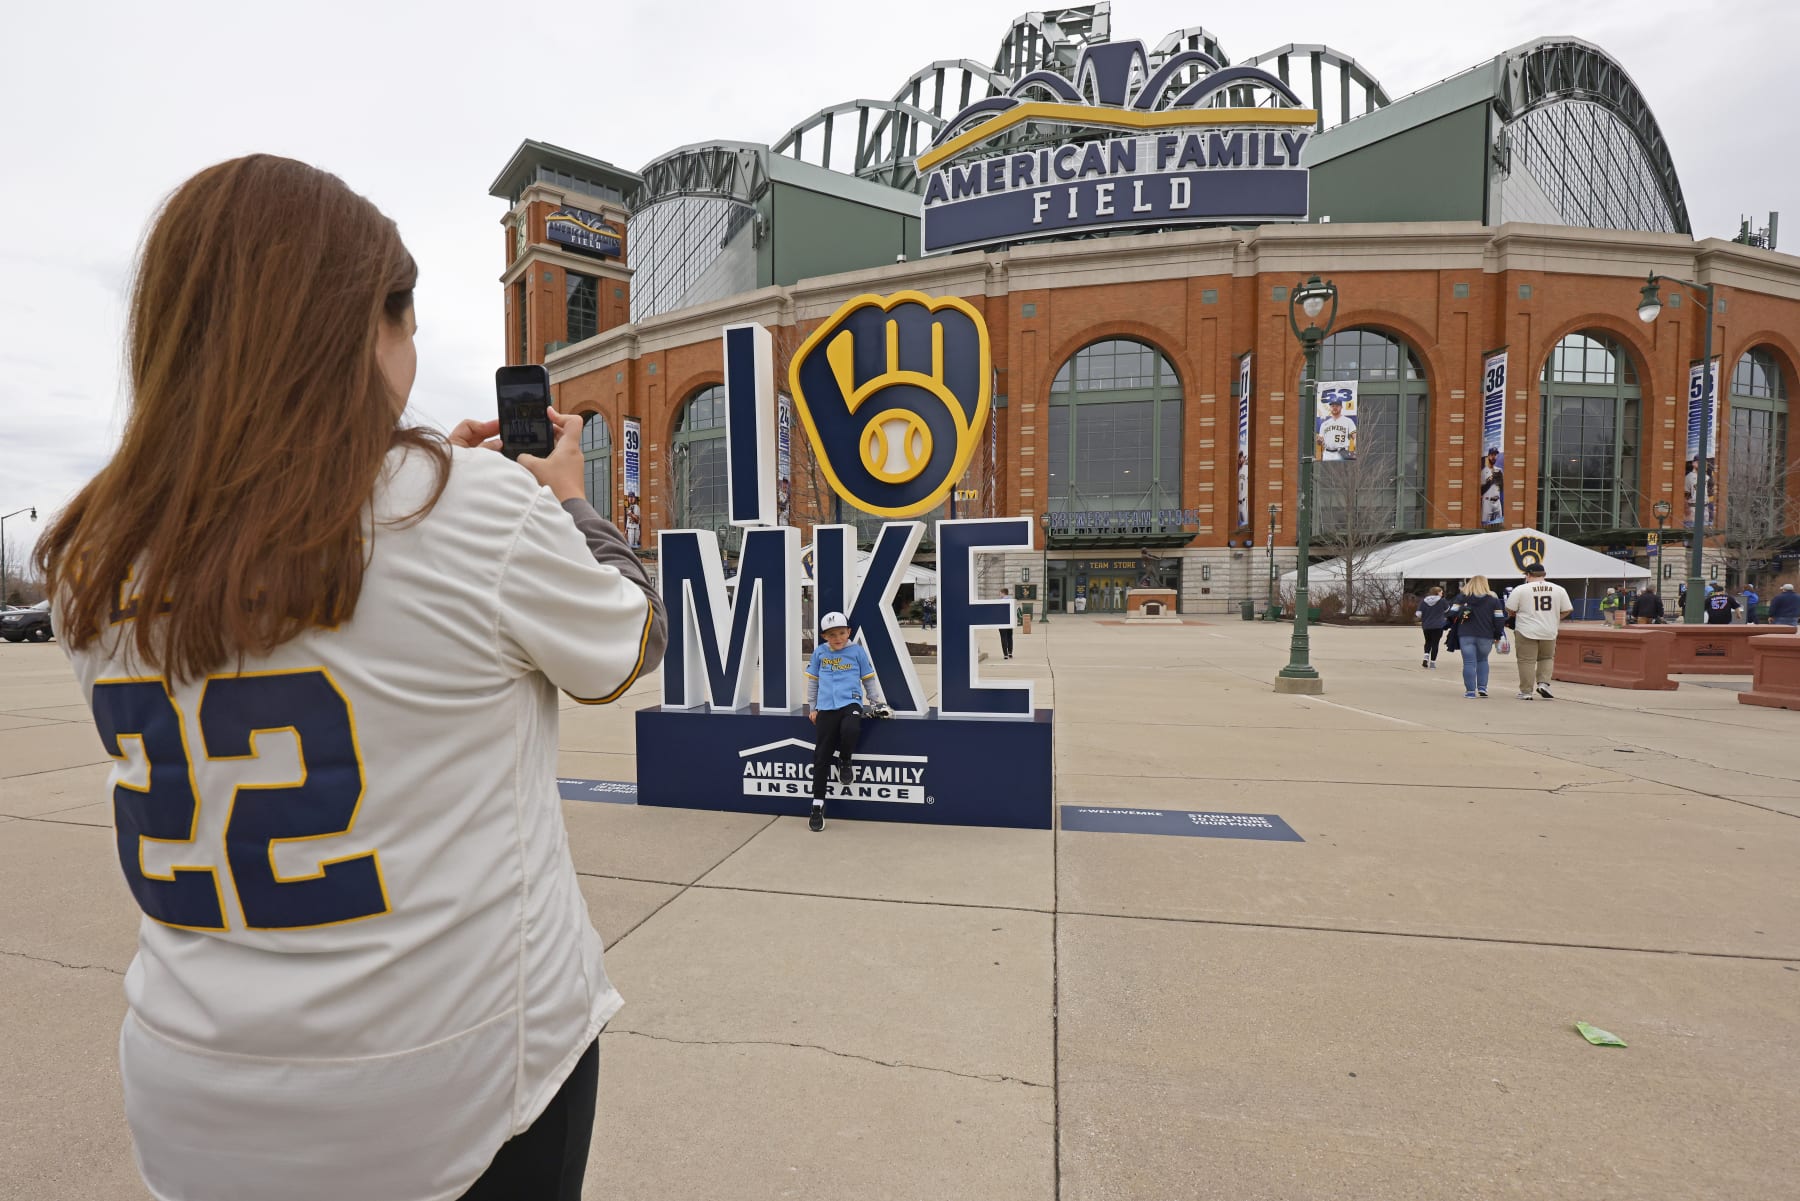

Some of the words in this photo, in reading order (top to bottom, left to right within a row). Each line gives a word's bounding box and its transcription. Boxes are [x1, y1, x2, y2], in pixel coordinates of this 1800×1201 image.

[923, 138, 1137, 206] AMERICAN
[1156, 131, 1309, 170] FAMILY
[1032, 176, 1192, 224] FIELD
[571, 235, 601, 249] FIELD
[1486, 364, 1505, 393] 38
[1321, 388, 1353, 404] 53
[723, 323, 775, 527] I
[779, 405, 790, 427] 24
[625, 430, 639, 450] 39
[1334, 434, 1346, 443] 53
[957, 489, 977, 500] TM
[1051, 511, 1111, 528] BREWERS
[1118, 510, 1151, 527] TEAM
[1158, 508, 1200, 526] STORE
[1113, 561, 1136, 569] STORE
[1533, 595, 1552, 611] 18
[658, 517, 1034, 718] MKE
[743, 760, 841, 780] AMERICN
[852, 765, 925, 784] FAMILY
[92, 666, 392, 932] 22
[757, 782, 910, 799] INSURANCE
[1078, 808, 1163, 817] #WELOVEMKE
